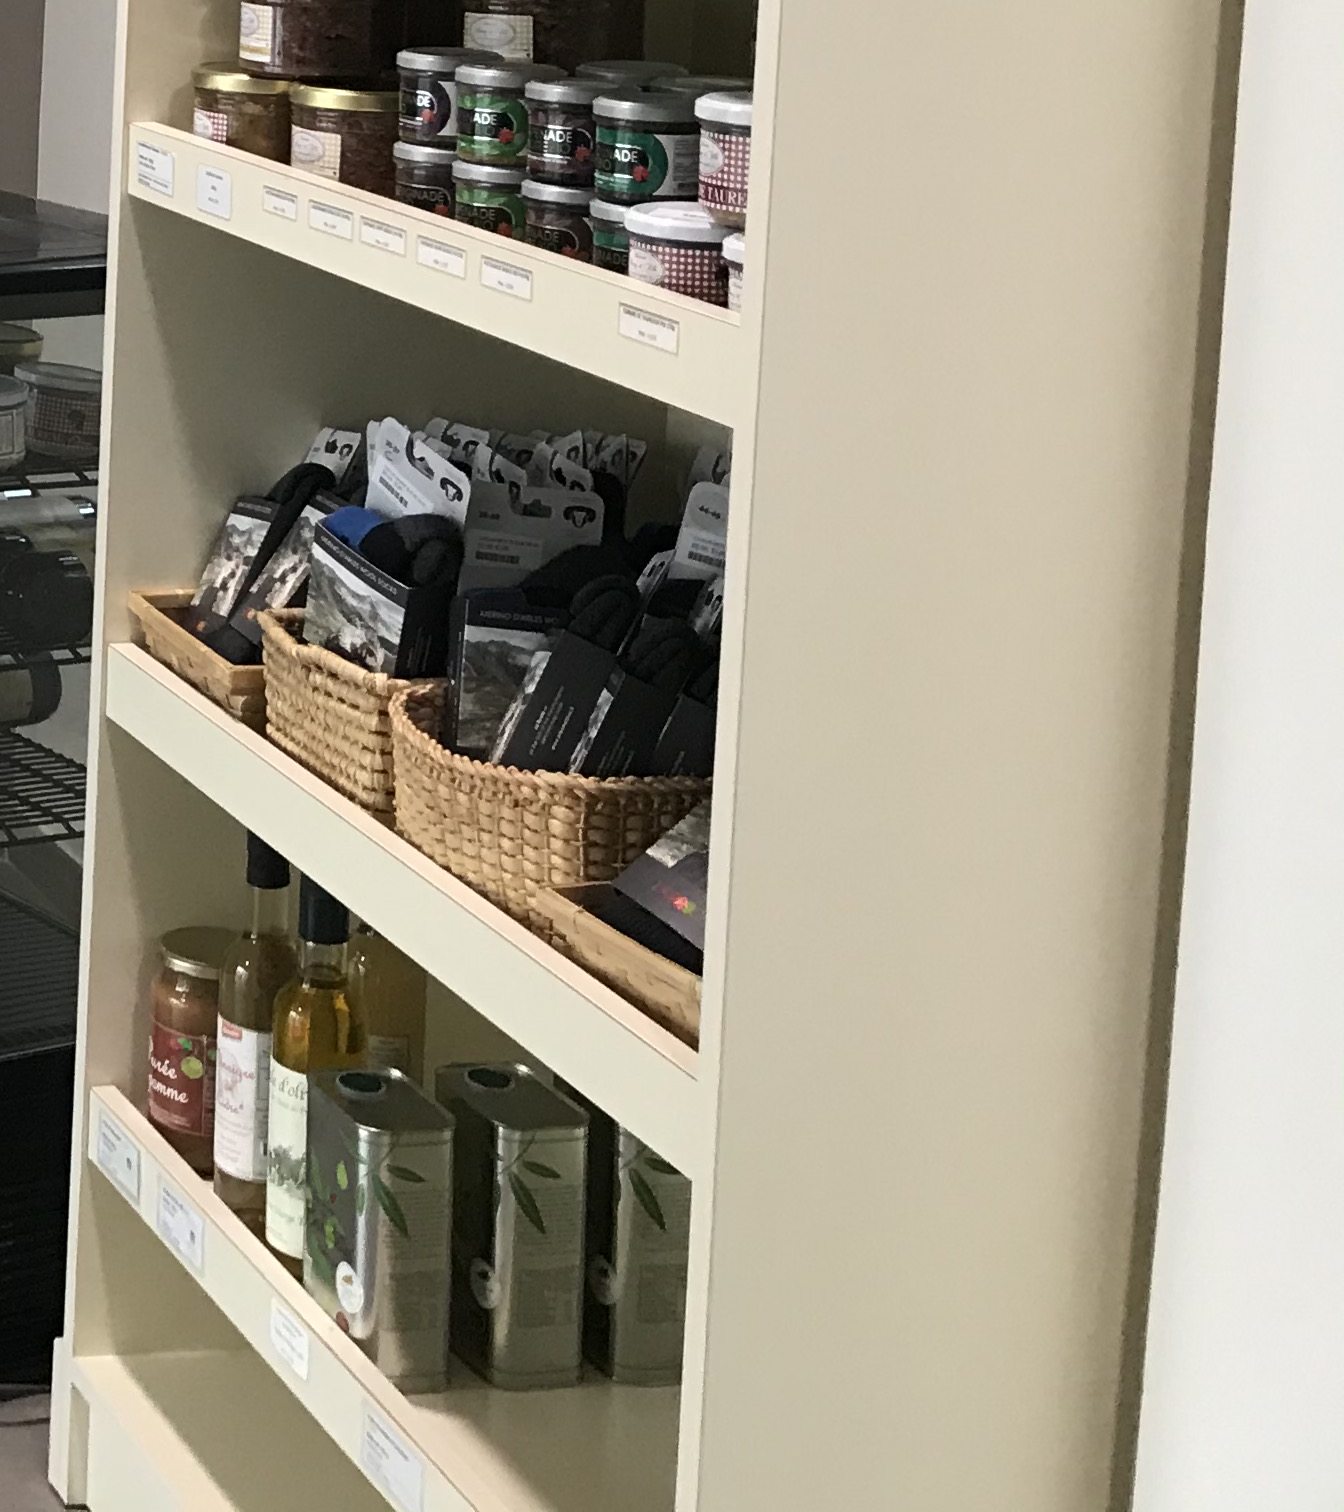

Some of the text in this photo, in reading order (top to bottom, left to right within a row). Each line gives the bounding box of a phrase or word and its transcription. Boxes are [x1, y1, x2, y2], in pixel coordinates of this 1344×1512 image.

[473, 112, 497, 125] ADE
[614, 150, 638, 163] ADE
[707, 186, 746, 206] TAURE
[464, 206, 496, 219] NADE
